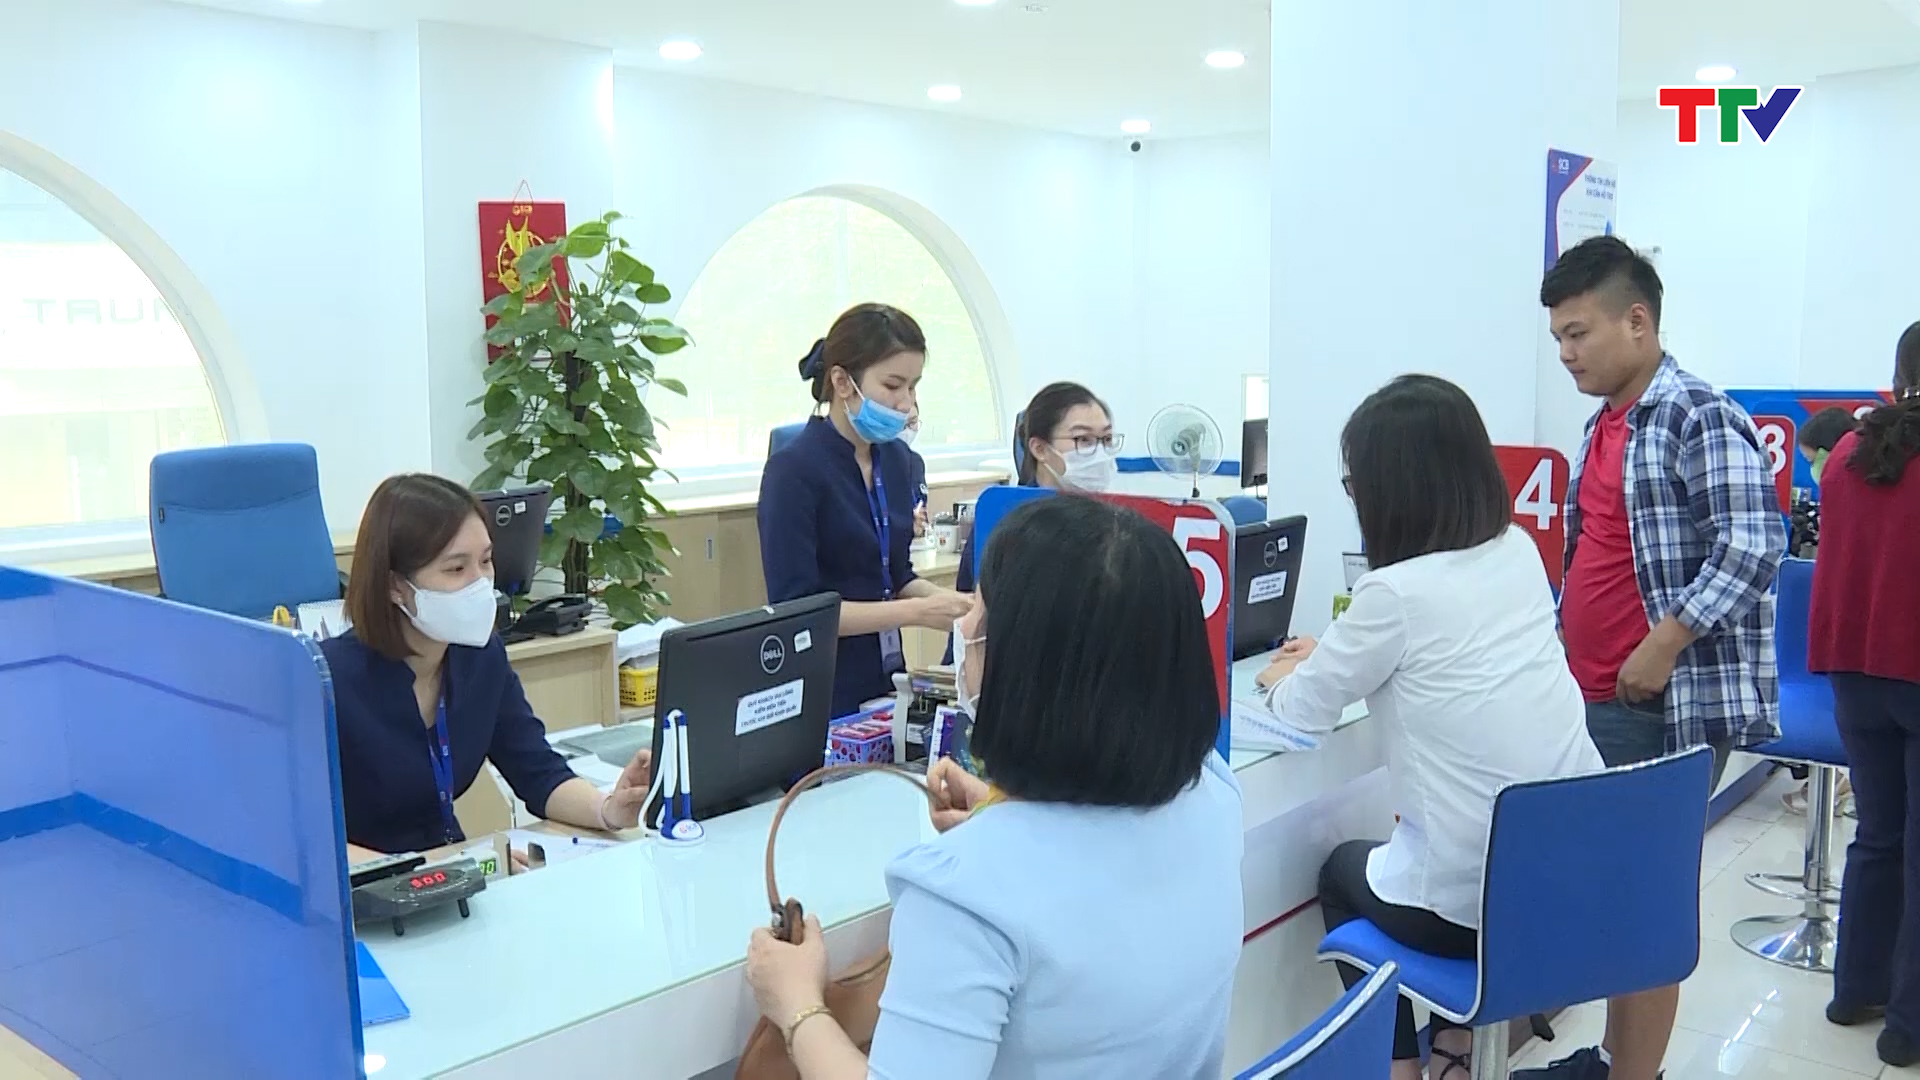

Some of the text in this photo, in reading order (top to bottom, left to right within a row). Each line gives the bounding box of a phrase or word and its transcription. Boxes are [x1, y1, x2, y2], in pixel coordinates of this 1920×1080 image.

[1514, 457, 1558, 530] 4
[1172, 516, 1224, 620] 5
[763, 648, 782, 662] DELL
